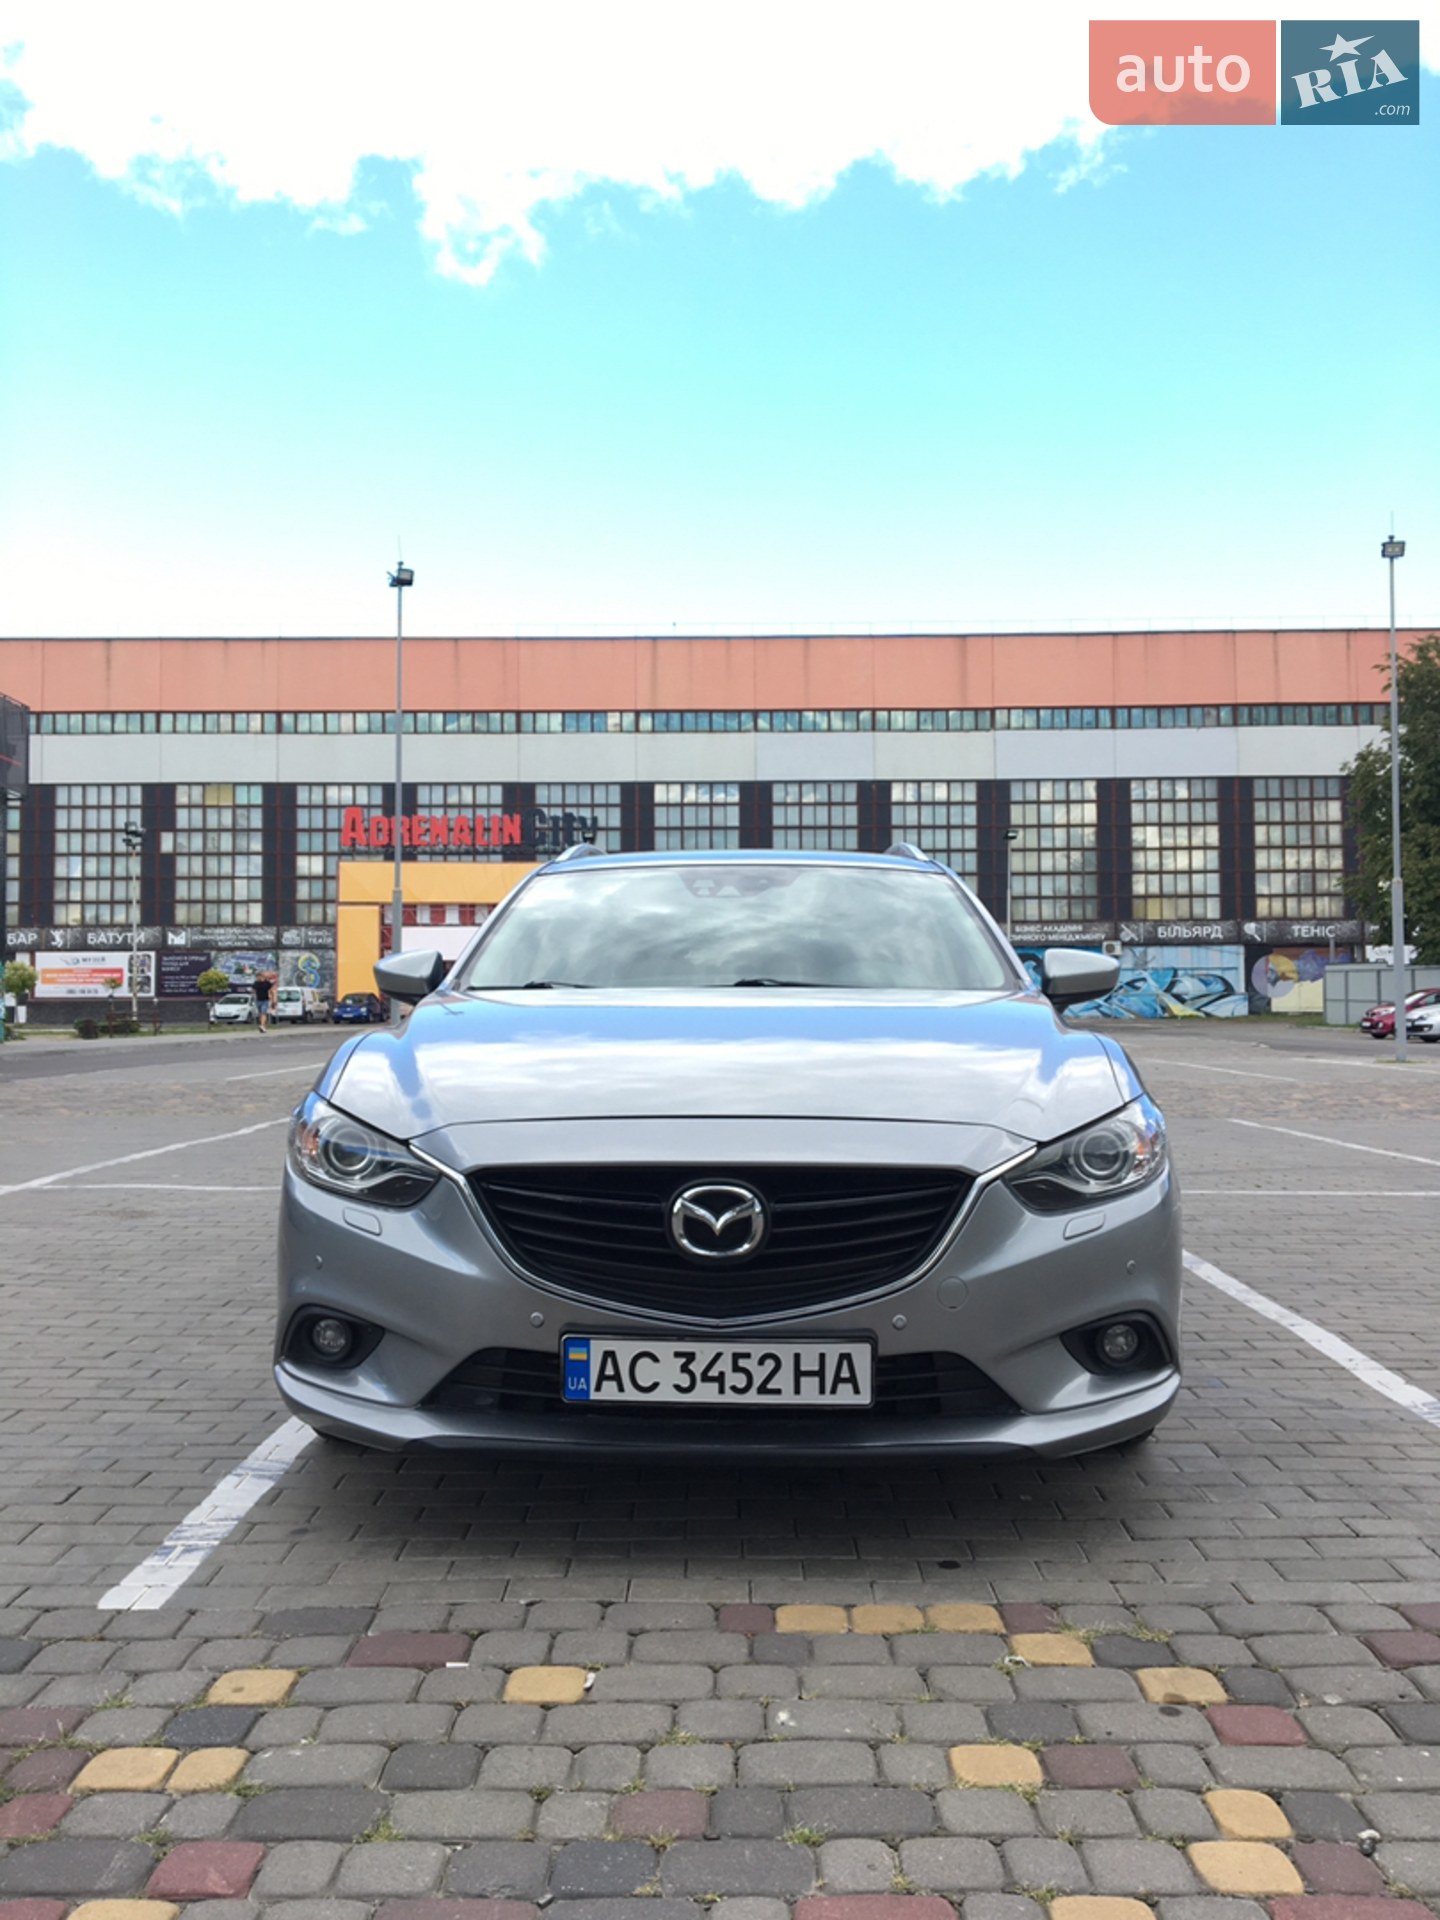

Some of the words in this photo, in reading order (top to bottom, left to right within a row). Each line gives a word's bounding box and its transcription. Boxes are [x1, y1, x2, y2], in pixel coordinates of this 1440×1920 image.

[341, 807, 522, 848] ADRENALIN
[7, 933, 38, 945] БАР
[87, 932, 145, 944] БАТУТИ
[1157, 925, 1224, 940] БІЛЬЯРД
[1292, 925, 1336, 938] ТЕНІС
[594, 1349, 661, 1394] AC
[672, 1351, 783, 1396] 3452
[793, 1352, 861, 1396] HA
[568, 1376, 588, 1391] UA
